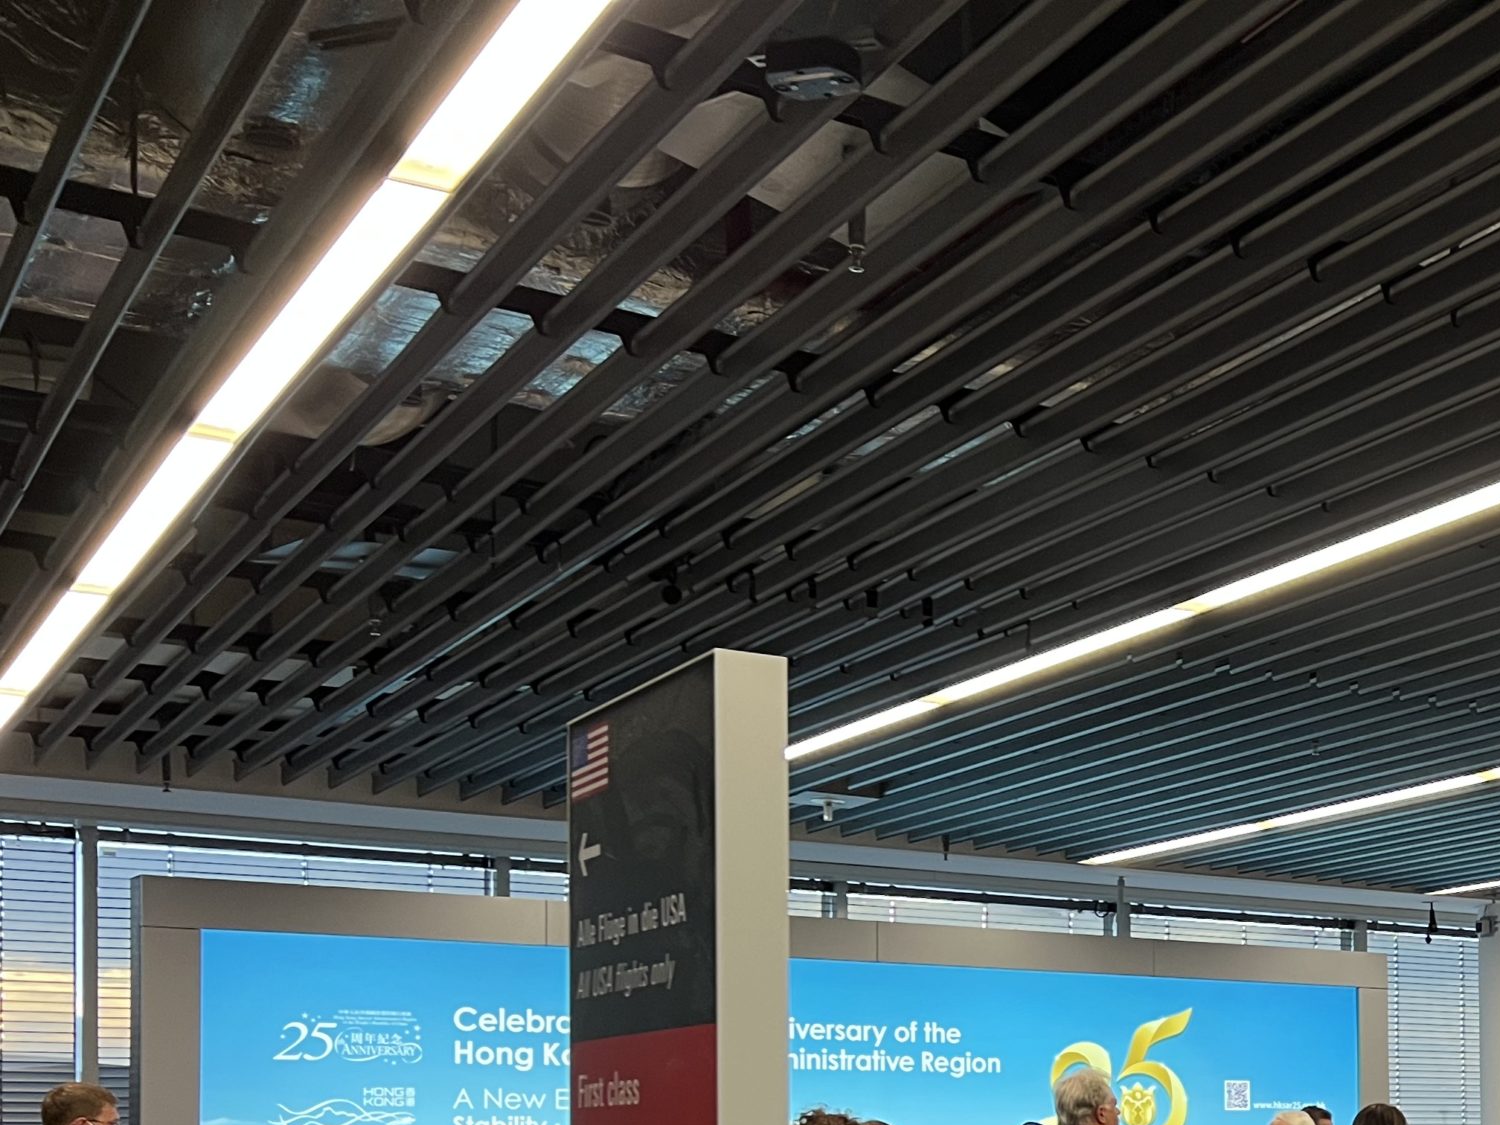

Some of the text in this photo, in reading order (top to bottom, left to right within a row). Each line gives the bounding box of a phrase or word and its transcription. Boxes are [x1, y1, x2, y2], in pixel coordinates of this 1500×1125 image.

[577, 892, 687, 948] Alle Flüge in die USA
[576, 953, 676, 999] All USA flights only
[272, 1021, 338, 1061] 25
[894, 1020, 918, 1043] of
[923, 1021, 962, 1044] the
[342, 1043, 417, 1057] ANNIVERSARY
[454, 1039, 534, 1072] Hong
[921, 1050, 1002, 1078] Region
[362, 1087, 405, 1097] HONG
[362, 1097, 405, 1107] KONG
[452, 1087, 475, 1110] A
[483, 1087, 547, 1110] New
[578, 1071, 641, 1109] First class
